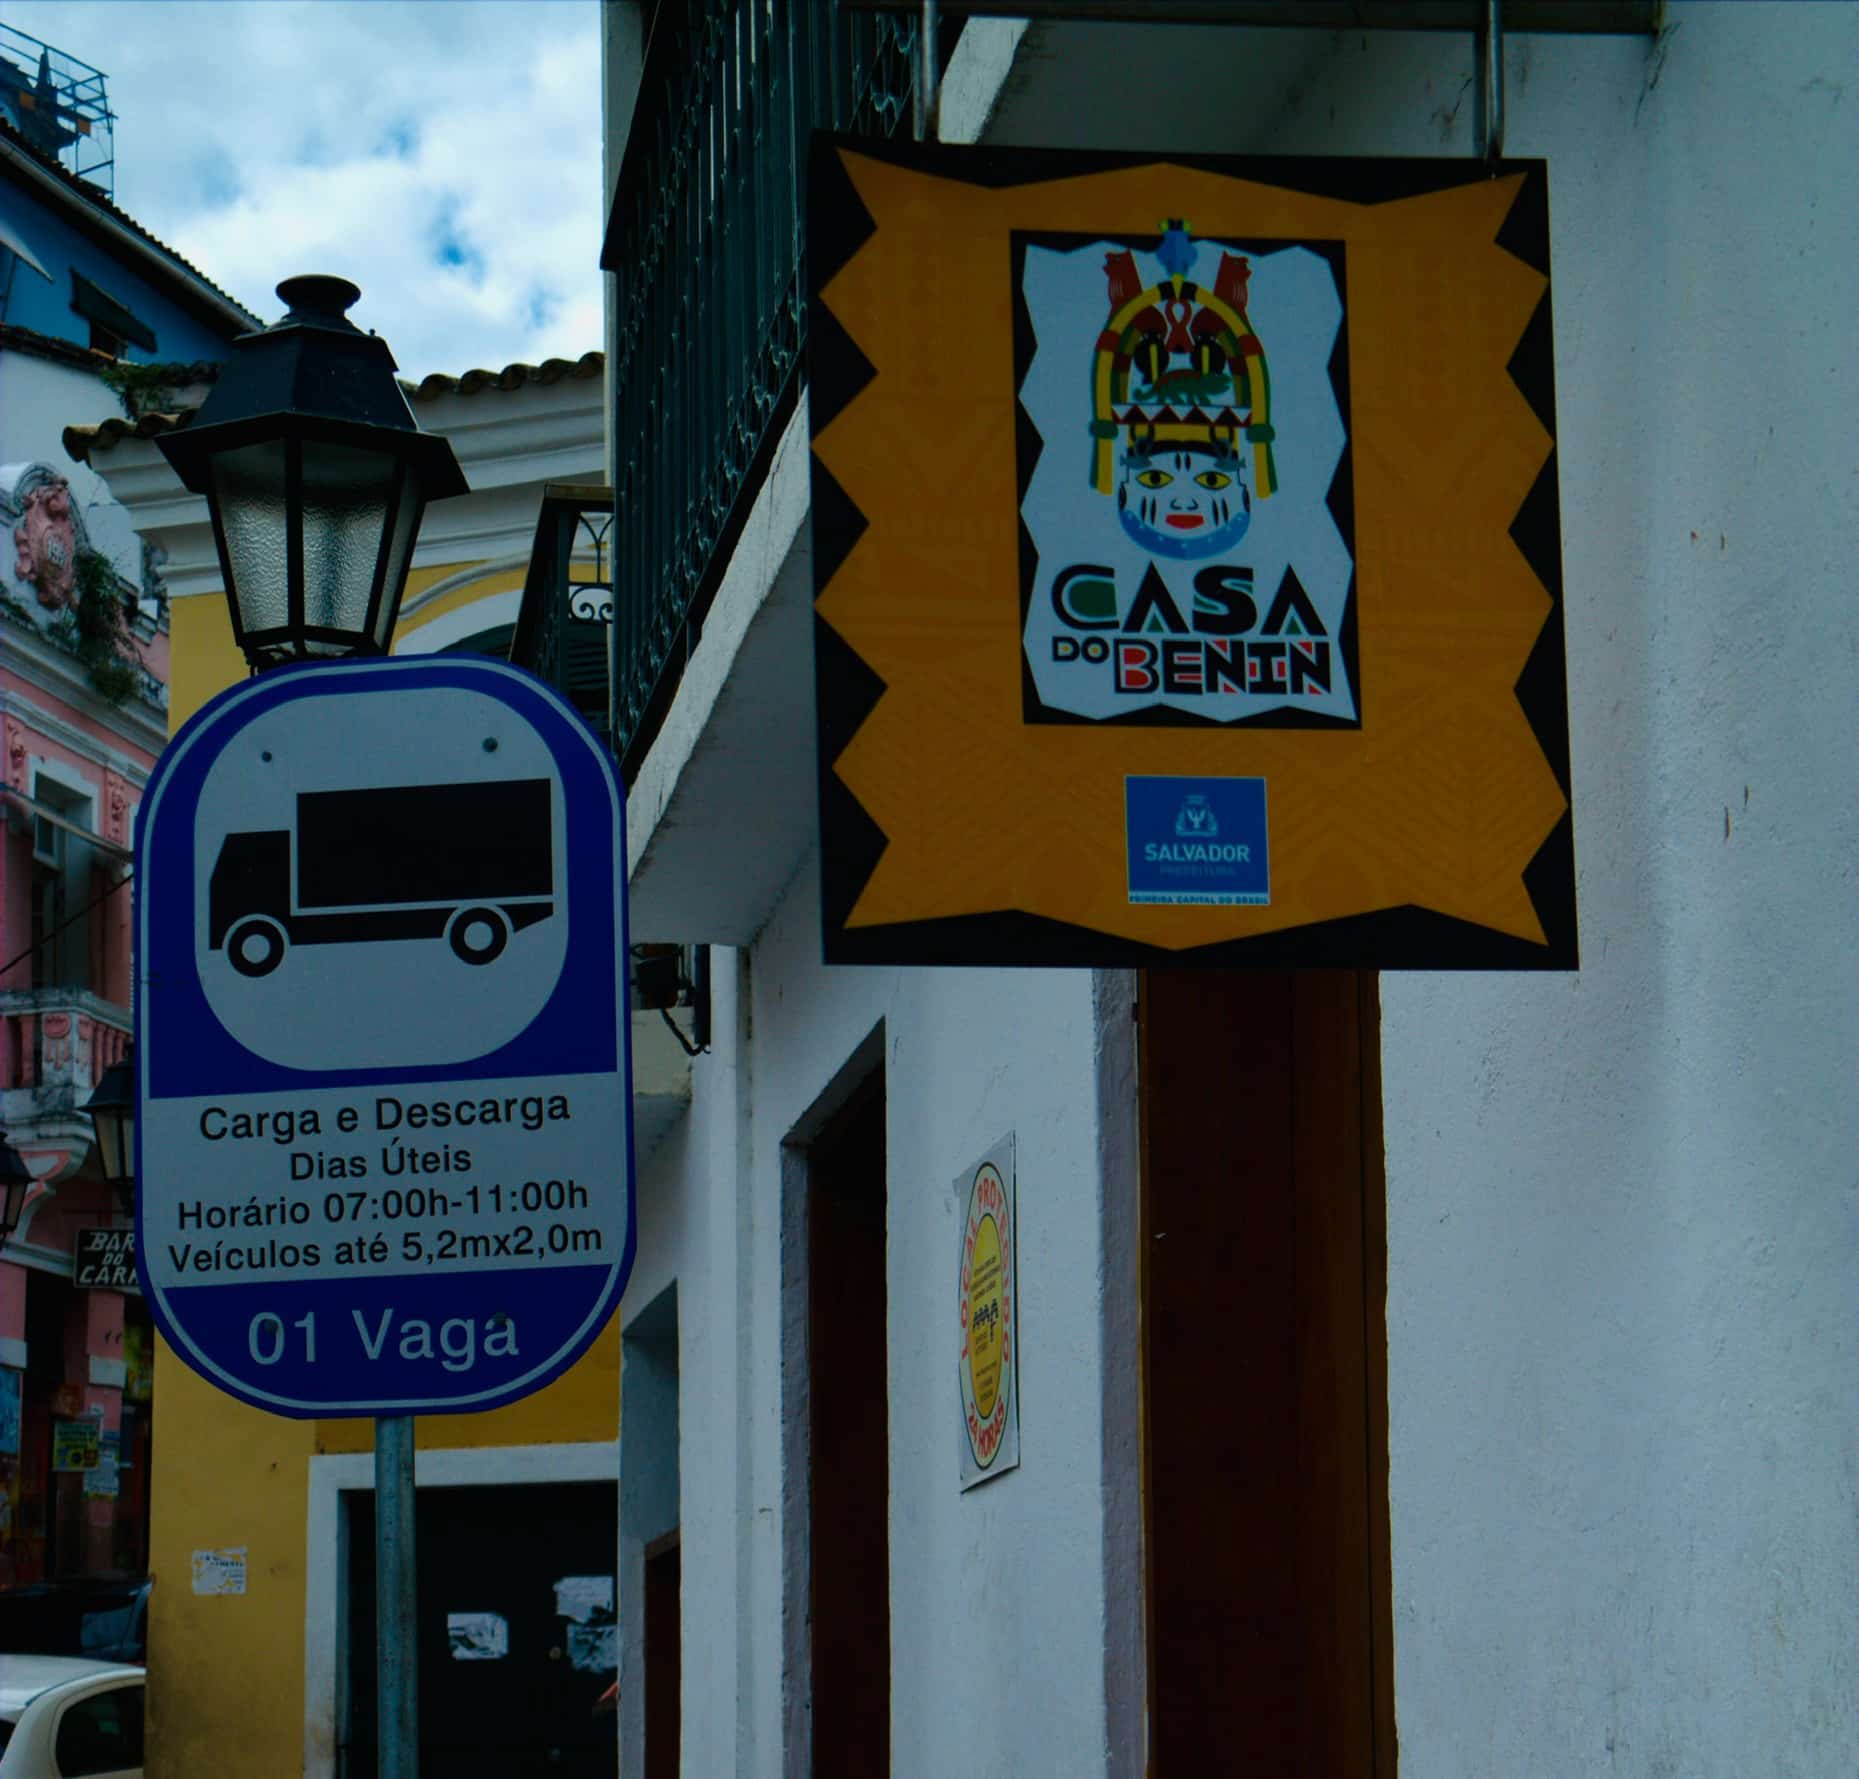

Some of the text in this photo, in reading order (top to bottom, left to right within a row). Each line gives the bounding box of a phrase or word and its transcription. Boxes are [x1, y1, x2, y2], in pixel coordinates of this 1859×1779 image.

[1051, 560, 1328, 636] CASA
[1052, 636, 1332, 695] DO BENIN
[1143, 843, 1251, 864] SALVADOR
[200, 1095, 570, 1145] Carga e Descarga
[290, 1136, 472, 1181] Dias Úteis
[178, 1179, 588, 1230] Horário 07:00h-11:00h
[82, 1231, 136, 1253] BAR
[101, 1252, 126, 1265] DO
[168, 1223, 602, 1273] Veículos até 5,2mx2,0m
[249, 1307, 520, 1372] 01 Vaga
